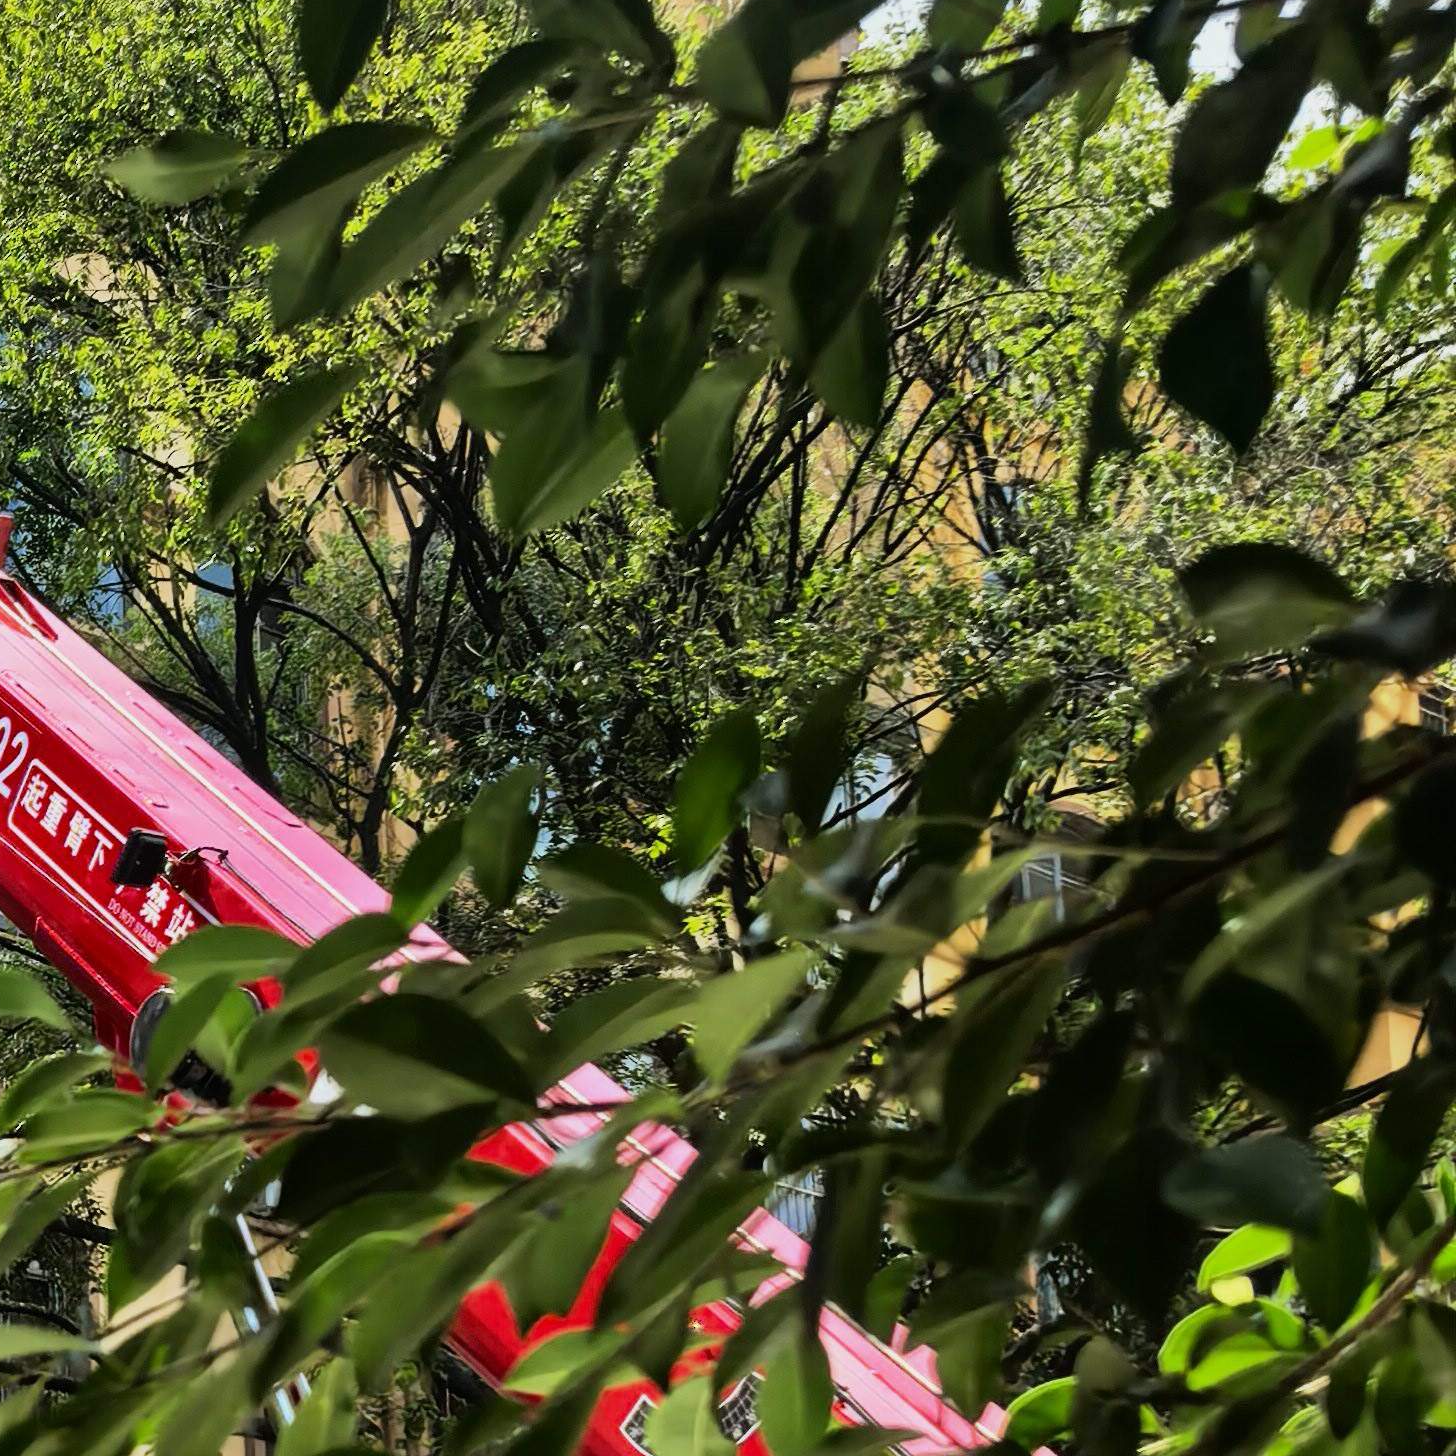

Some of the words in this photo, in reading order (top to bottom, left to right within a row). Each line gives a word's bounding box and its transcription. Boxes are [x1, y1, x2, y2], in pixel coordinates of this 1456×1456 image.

[20, 773, 195, 944] 起重臂下禁站
